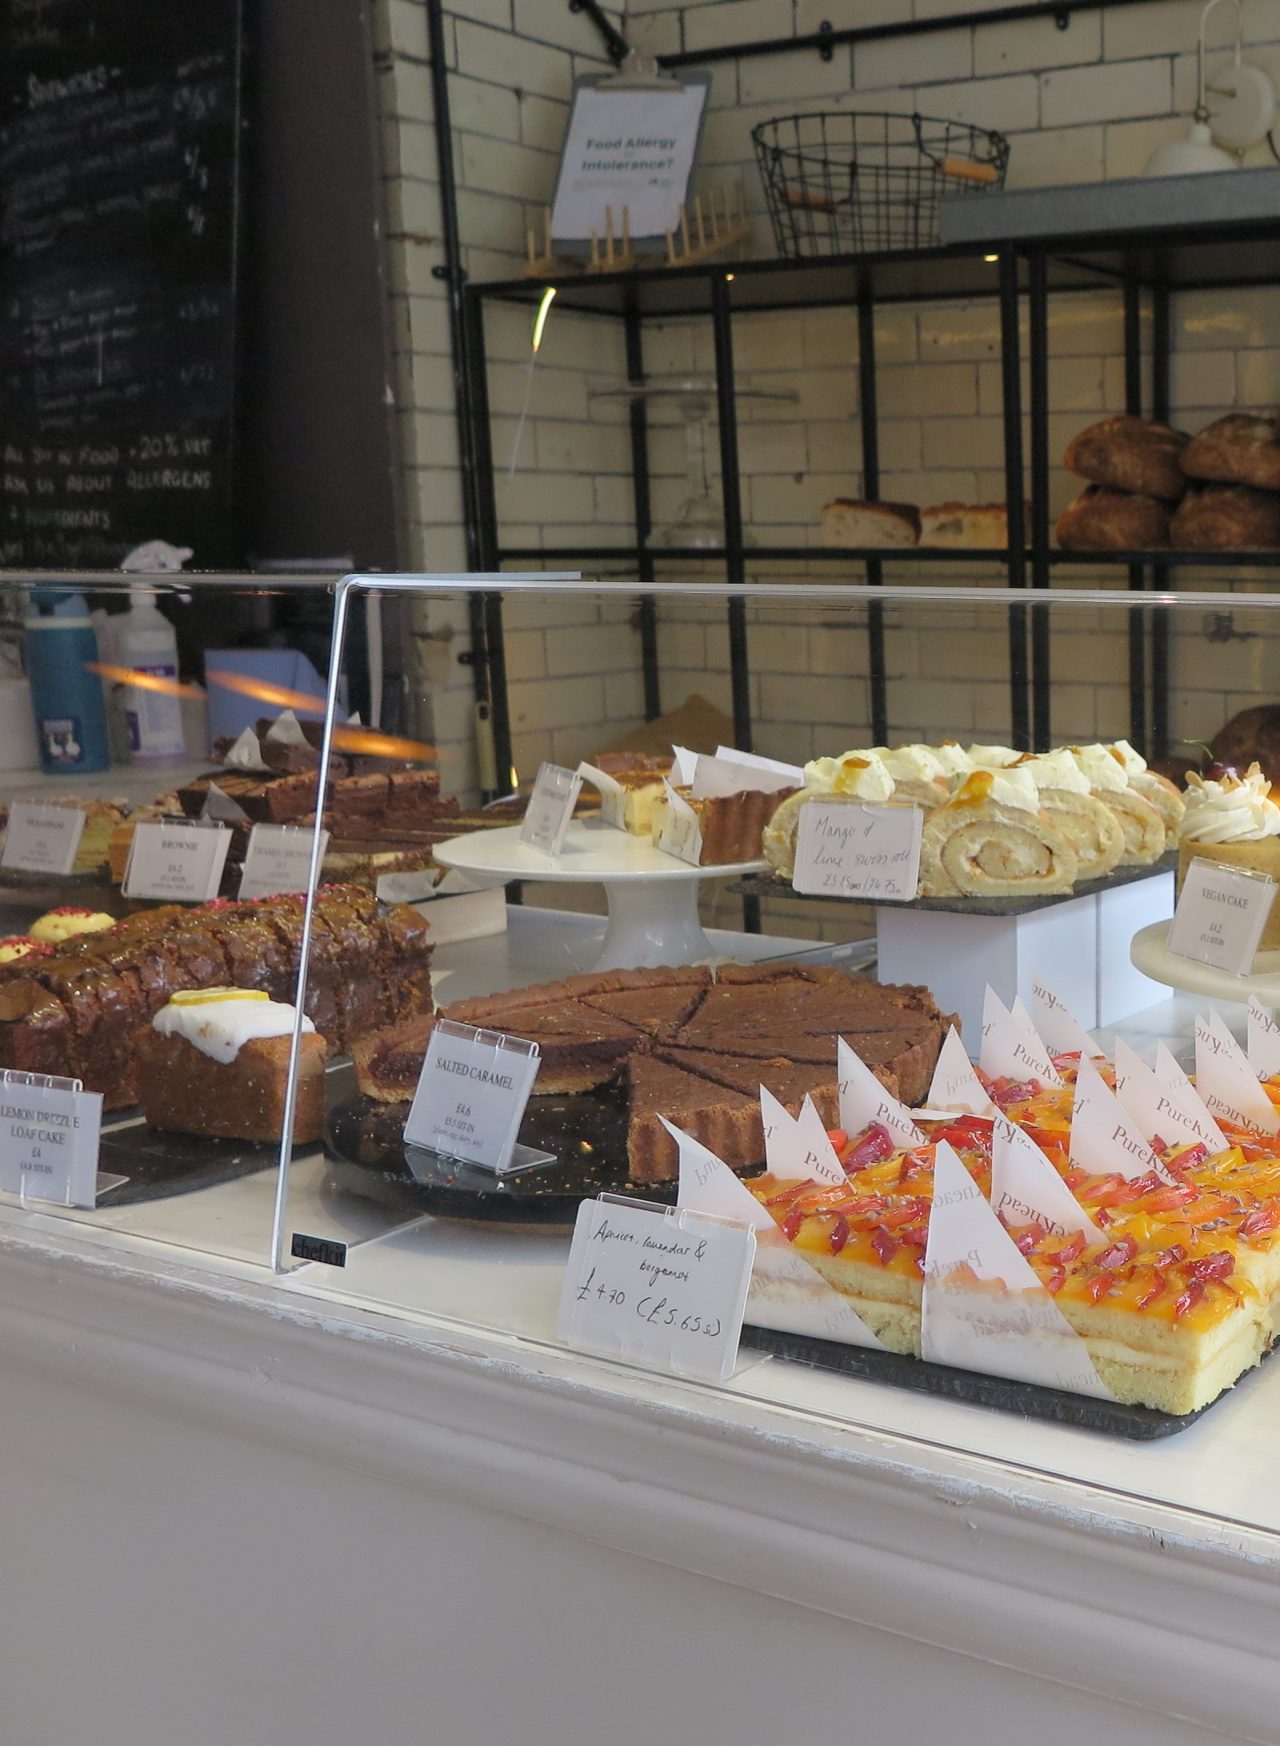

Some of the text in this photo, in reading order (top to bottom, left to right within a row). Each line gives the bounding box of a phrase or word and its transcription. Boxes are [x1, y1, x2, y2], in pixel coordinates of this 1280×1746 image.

[586, 137, 677, 150] Food Allergy
[581, 158, 675, 172] Intolerance?
[815, 816, 856, 850] Mango
[1202, 888, 1249, 909] VEGAN CAKE
[435, 1057, 514, 1090] SALTED CARAMEL
[1, 1105, 80, 1129] LEMON DRIZZLE
[11, 1125, 66, 1146] LOAF CAKE
[694, 1239, 708, 1262] &
